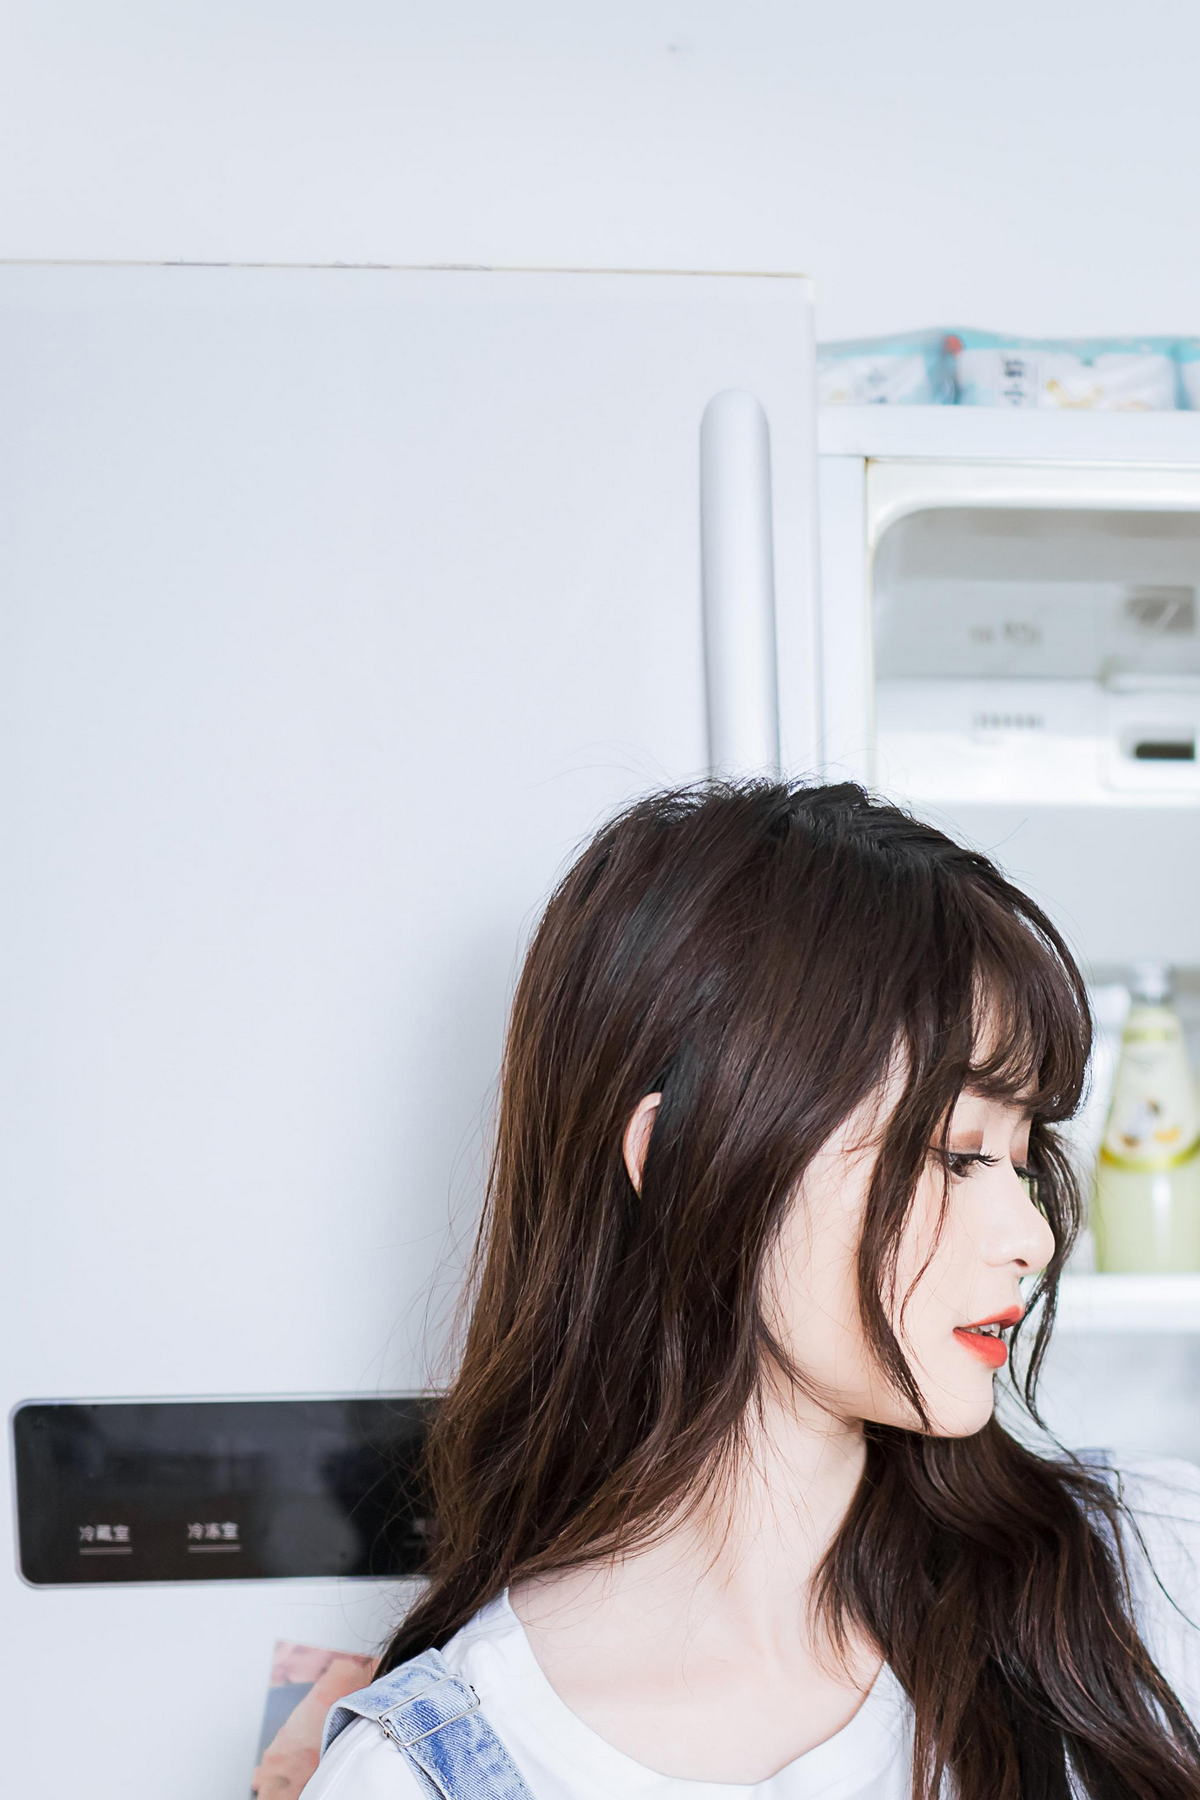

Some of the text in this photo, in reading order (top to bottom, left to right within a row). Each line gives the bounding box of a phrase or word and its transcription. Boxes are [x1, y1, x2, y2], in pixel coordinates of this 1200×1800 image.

[79, 1524, 130, 1542] 冷藏室
[187, 1521, 239, 1540] 冷冻室
